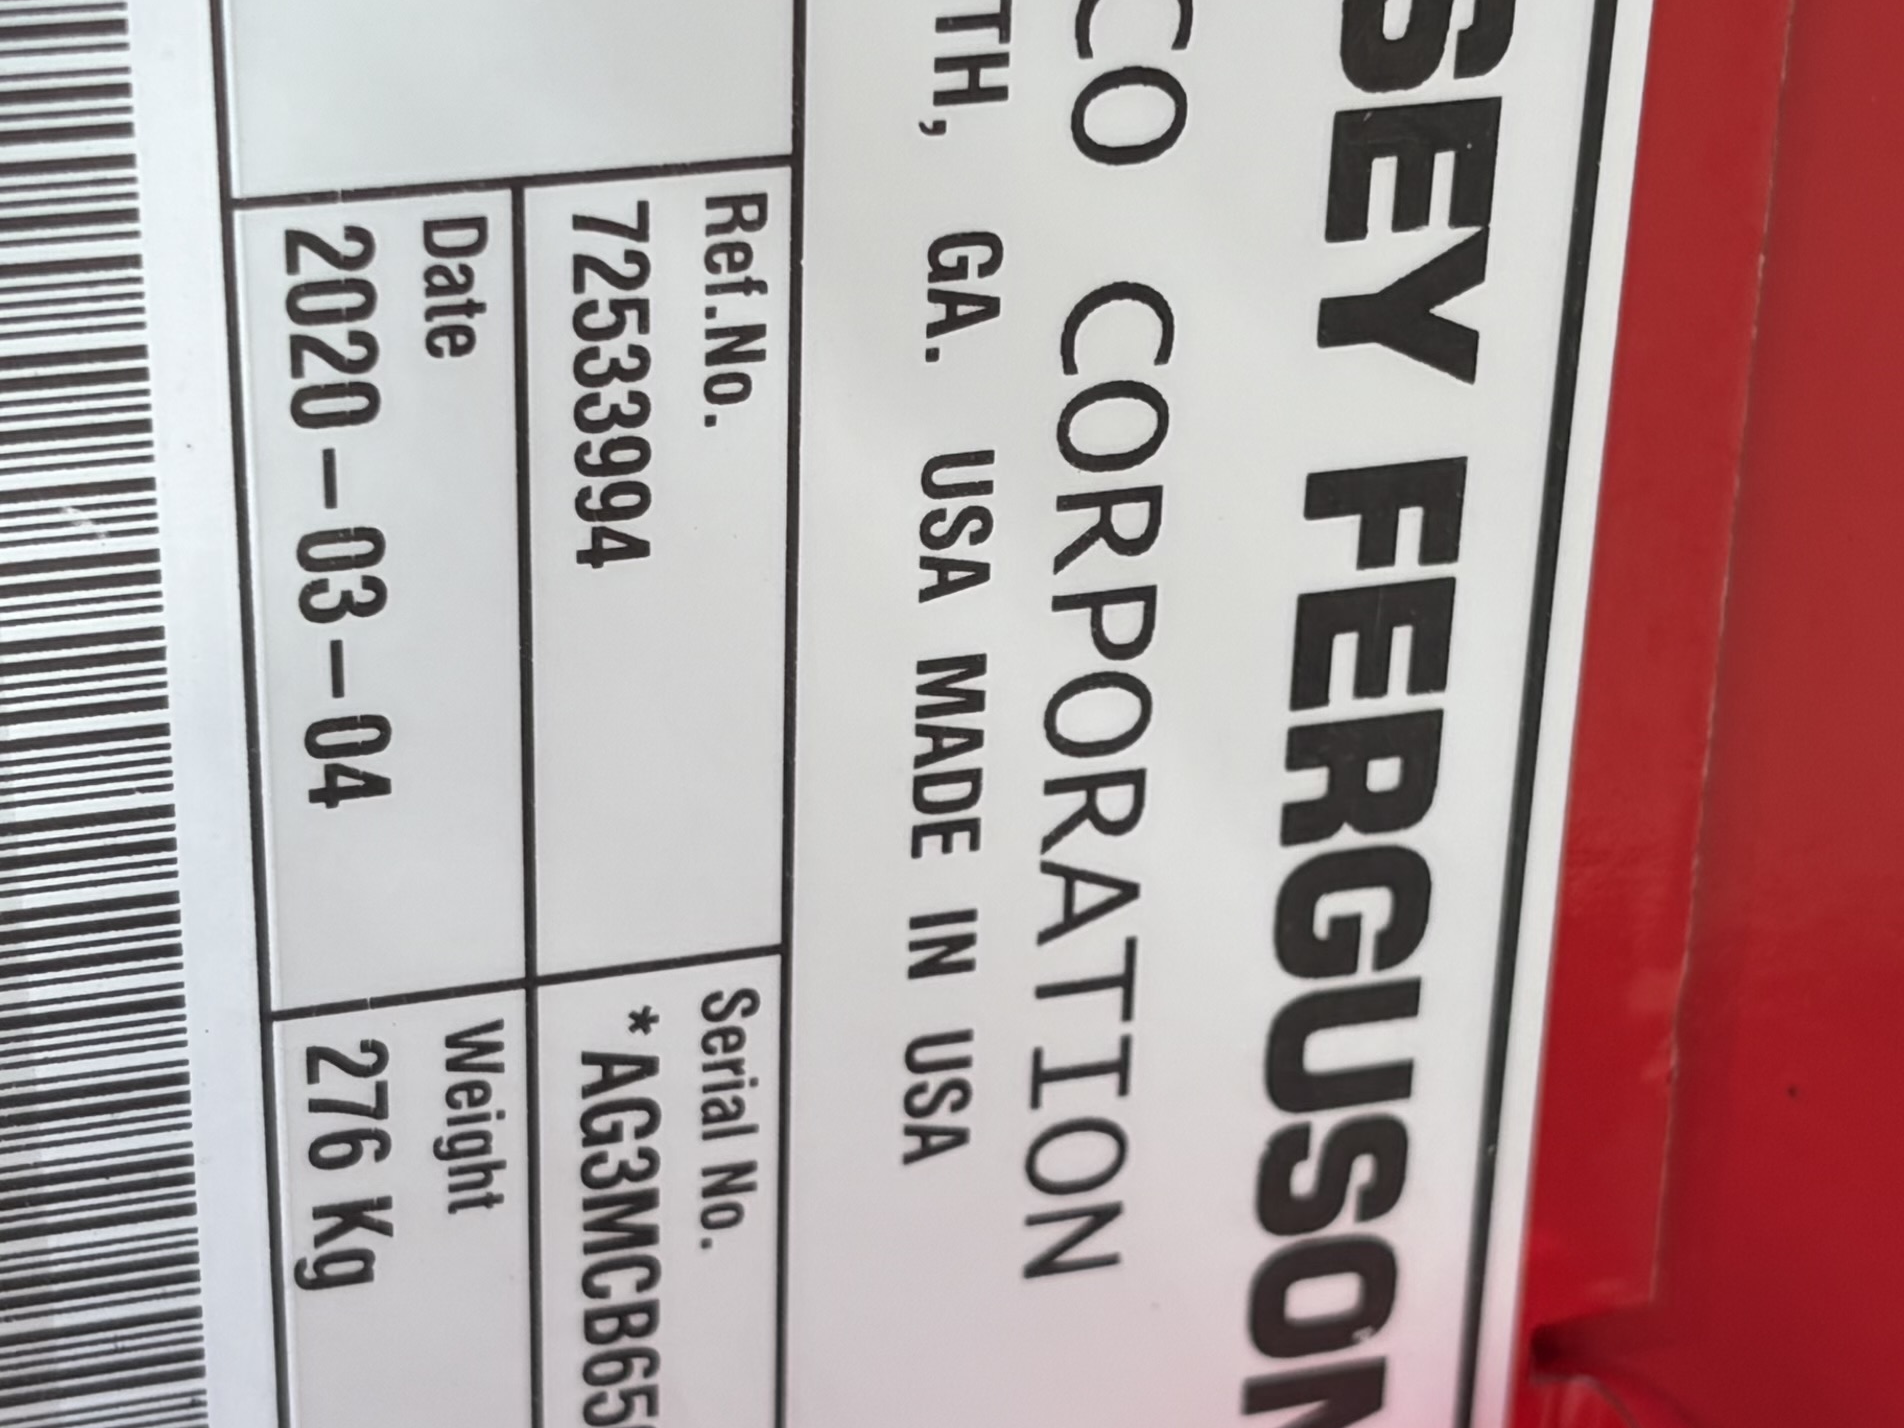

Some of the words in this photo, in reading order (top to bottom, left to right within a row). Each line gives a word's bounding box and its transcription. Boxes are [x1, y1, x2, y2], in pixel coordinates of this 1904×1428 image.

[421, 214, 489, 360] Date
[702, 191, 770, 429] Ref.No.
[924, 230, 1005, 364] GA.
[570, 199, 653, 570] 72533994
[917, 448, 996, 605] USA
[909, 652, 988, 861] MADE
[1021, 279, 1176, 1281] CORPORATION
[906, 907, 979, 981] IN
[304, 1038, 393, 1172] 276
[431, 1018, 508, 1216] Weight
[699, 987, 762, 1142] Serial
[901, 1028, 974, 1167] USA
[290, 1194, 395, 1292] Kg
[698, 1159, 759, 1251] No.
